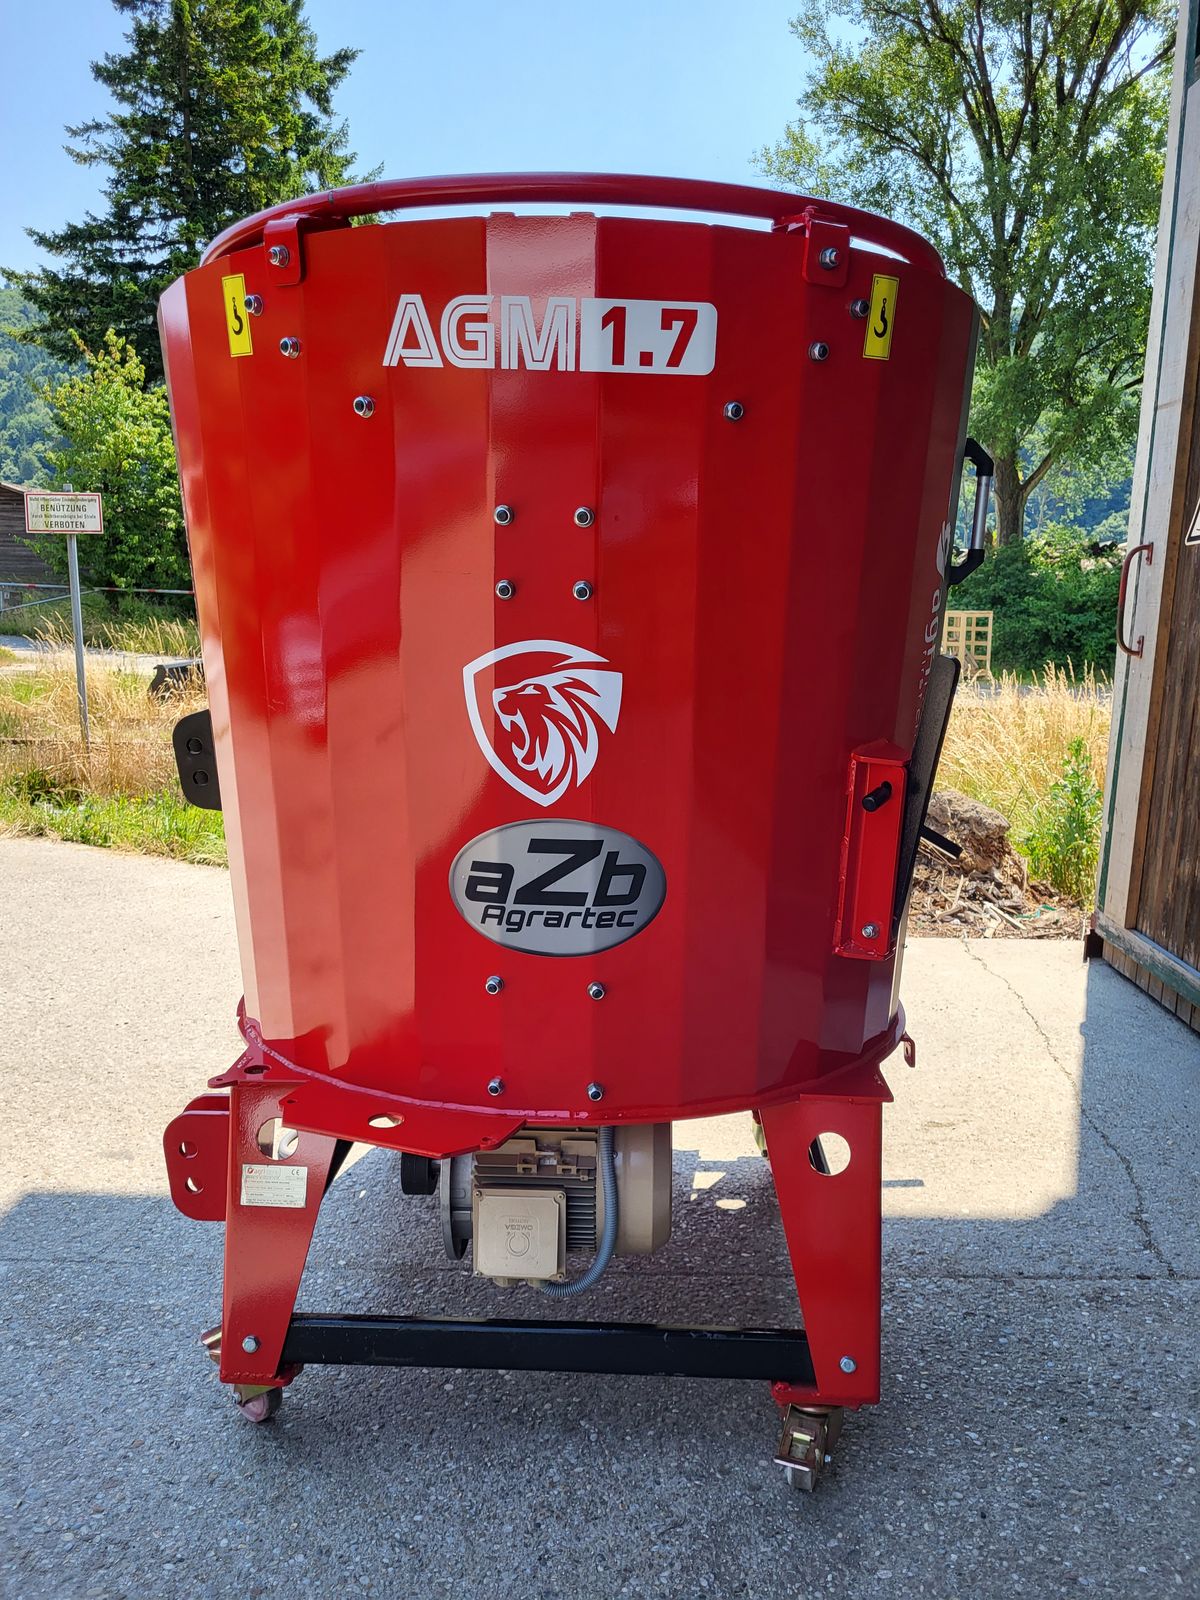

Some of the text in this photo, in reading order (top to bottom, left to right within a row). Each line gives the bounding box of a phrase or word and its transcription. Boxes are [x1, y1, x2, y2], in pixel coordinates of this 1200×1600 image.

[382, 294, 698, 371] AGM 1.7
[40, 503, 87, 512] BENÜTZUNG
[481, 904, 638, 932] Agrartec
